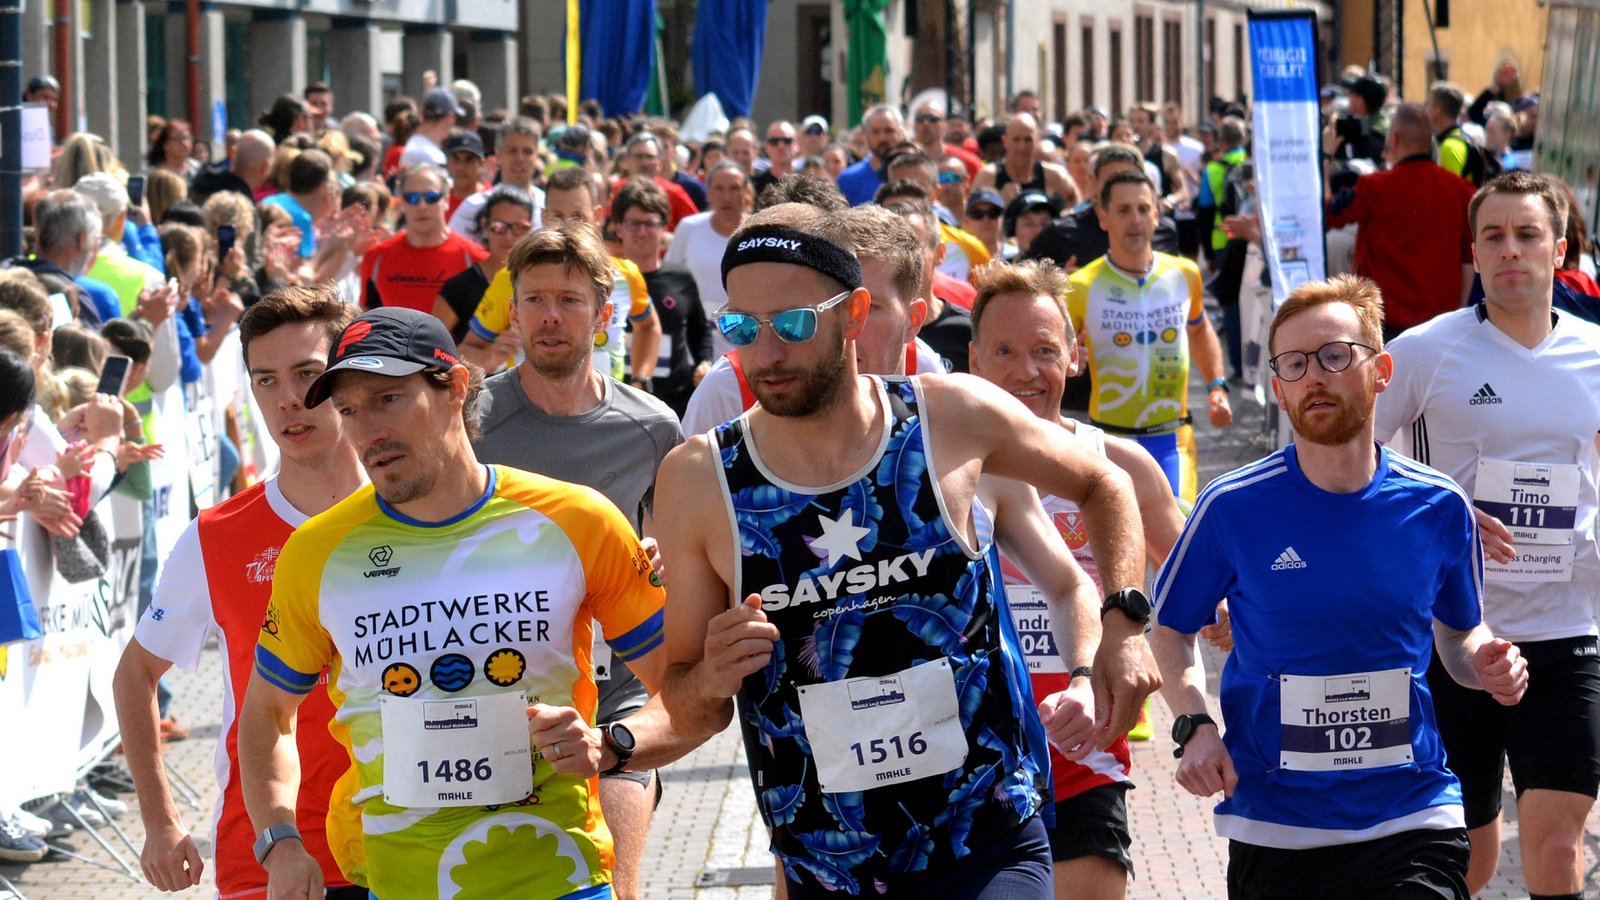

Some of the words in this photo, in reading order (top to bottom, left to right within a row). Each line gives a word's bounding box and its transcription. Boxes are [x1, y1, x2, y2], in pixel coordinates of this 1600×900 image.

[737, 237, 802, 252] SAYSKY
[1469, 395, 1503, 406] adidas
[1510, 488, 1550, 505] Timo
[1510, 507, 1545, 527] 111
[1513, 531, 1538, 539] MAHLE
[1271, 560, 1308, 571] adidas
[1522, 554, 1561, 564] Charging
[363, 567, 402, 579] VERGE
[760, 548, 937, 612] SAYSKY
[353, 590, 551, 639] STADTWERKE
[813, 595, 897, 620] copenhagen
[1019, 614, 1050, 630] ndr
[353, 619, 551, 669] MÜHLACKER
[1021, 634, 1051, 654] 04
[1302, 706, 1391, 725] Thorsten
[1325, 726, 1372, 750] 102
[850, 731, 928, 766] 1516
[1333, 756, 1363, 766] MAHLE
[417, 757, 492, 783] 1486
[876, 767, 912, 781] MAHLE
[438, 791, 473, 801] MAHLE
